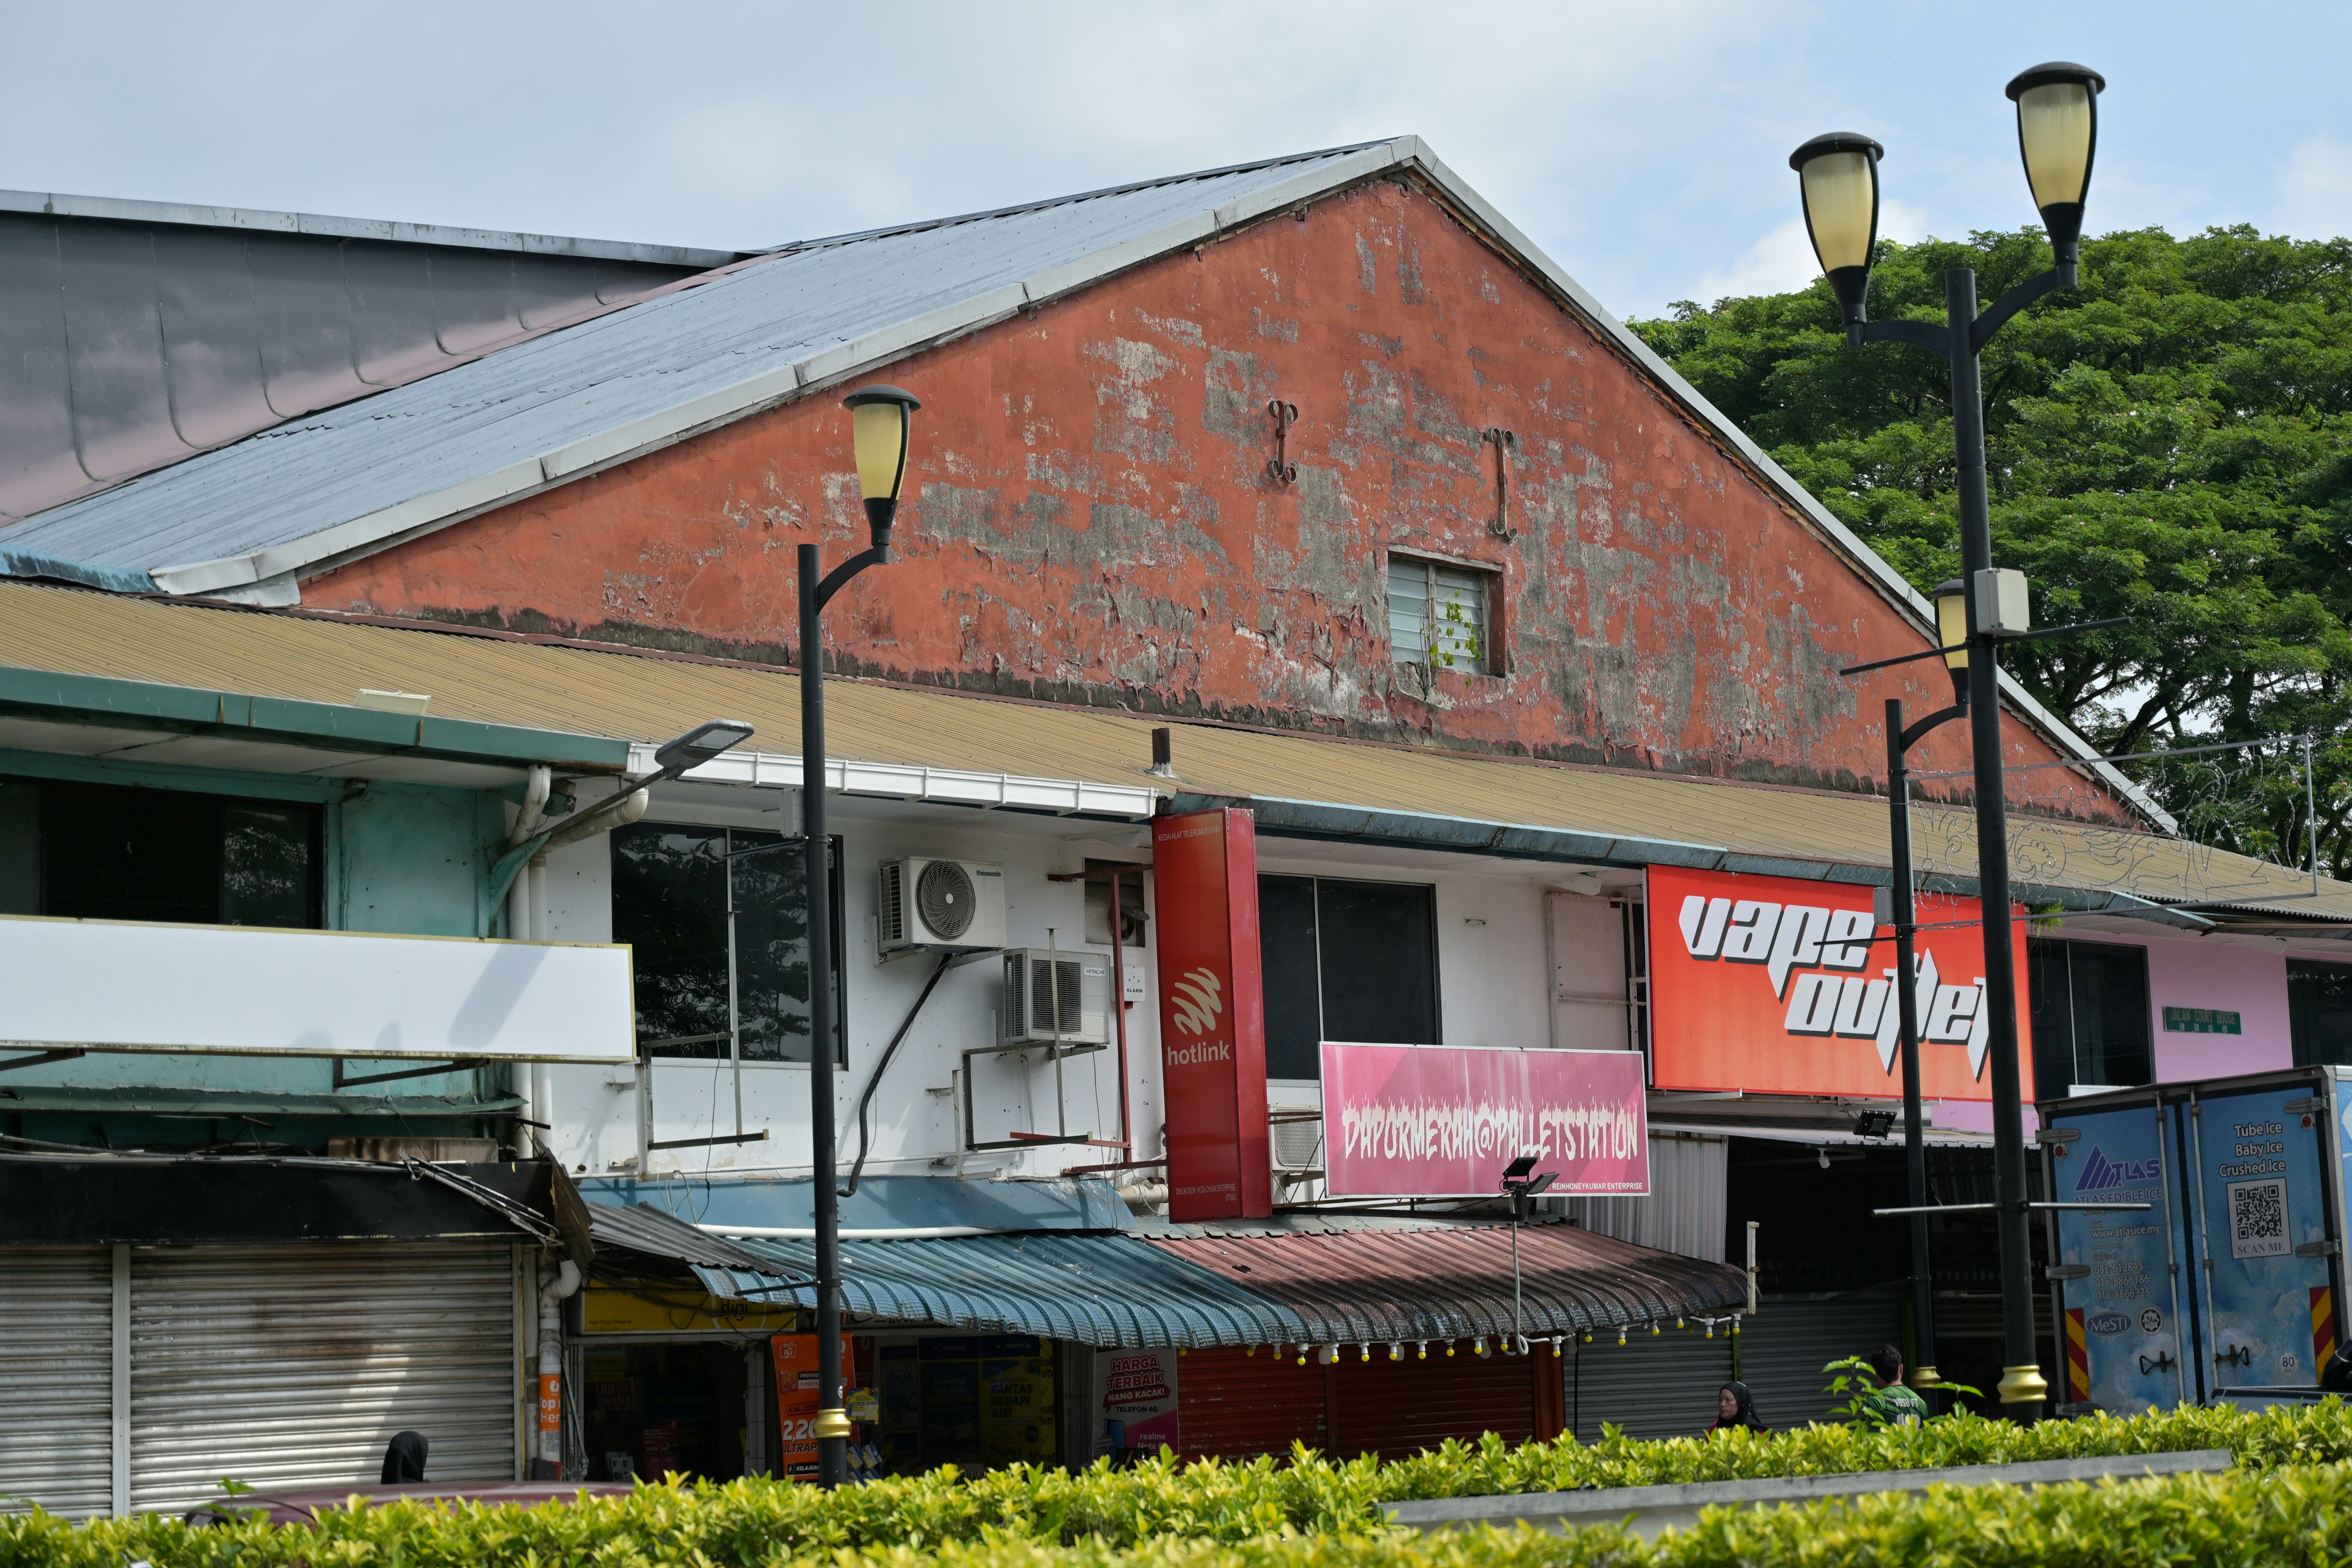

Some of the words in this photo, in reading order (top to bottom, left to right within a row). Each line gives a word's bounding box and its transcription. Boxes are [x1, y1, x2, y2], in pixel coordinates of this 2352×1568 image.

[1172, 831, 1182, 840] ALAT
[1183, 826, 1220, 838] TELEKOMUNIKASI
[1679, 895, 1877, 1002] vape
[2171, 1008, 2190, 1021] JALAN
[2194, 1010, 2212, 1023] COURT
[2217, 1011, 2236, 1025] HOUSE
[1167, 1040, 1230, 1066] hotlink
[2234, 1123, 2263, 1137] Tube
[2265, 1122, 2283, 1134] Ice
[2235, 1142, 2264, 1158] Baby
[2266, 1141, 2283, 1153] Ice
[2219, 1160, 2266, 1177] Crushed
[2269, 1159, 2286, 1172] Ice
[1217, 1184, 1236, 1192] ENTERPRISE
[2108, 1190, 2144, 1203] EDIBLE
[2146, 1188, 2163, 1200] ICE
[2092, 1225, 2160, 1238] www.atlasice.my
[2238, 1244, 2265, 1255] SCAN
[2268, 1242, 2284, 1252] ME
[2094, 1261, 2143, 1274] 082-612845
[2095, 1274, 2149, 1288] 016-8866186
[2096, 1287, 2150, 1301] 016-8866325
[2090, 1317, 2128, 1332] MeSTI
[784, 1347, 793, 1359] 5G
[1111, 1355, 1159, 1373] HARGA
[2283, 1357, 2294, 1367] 80
[1107, 1371, 1164, 1391] TERBAIK
[601, 1383, 614, 1395] NO
[991, 1383, 1033, 1394] PANTAS
[1108, 1391, 1133, 1401] NANG
[1135, 1388, 1165, 1398] KACAK!
[1140, 1432, 1166, 1440] realme
